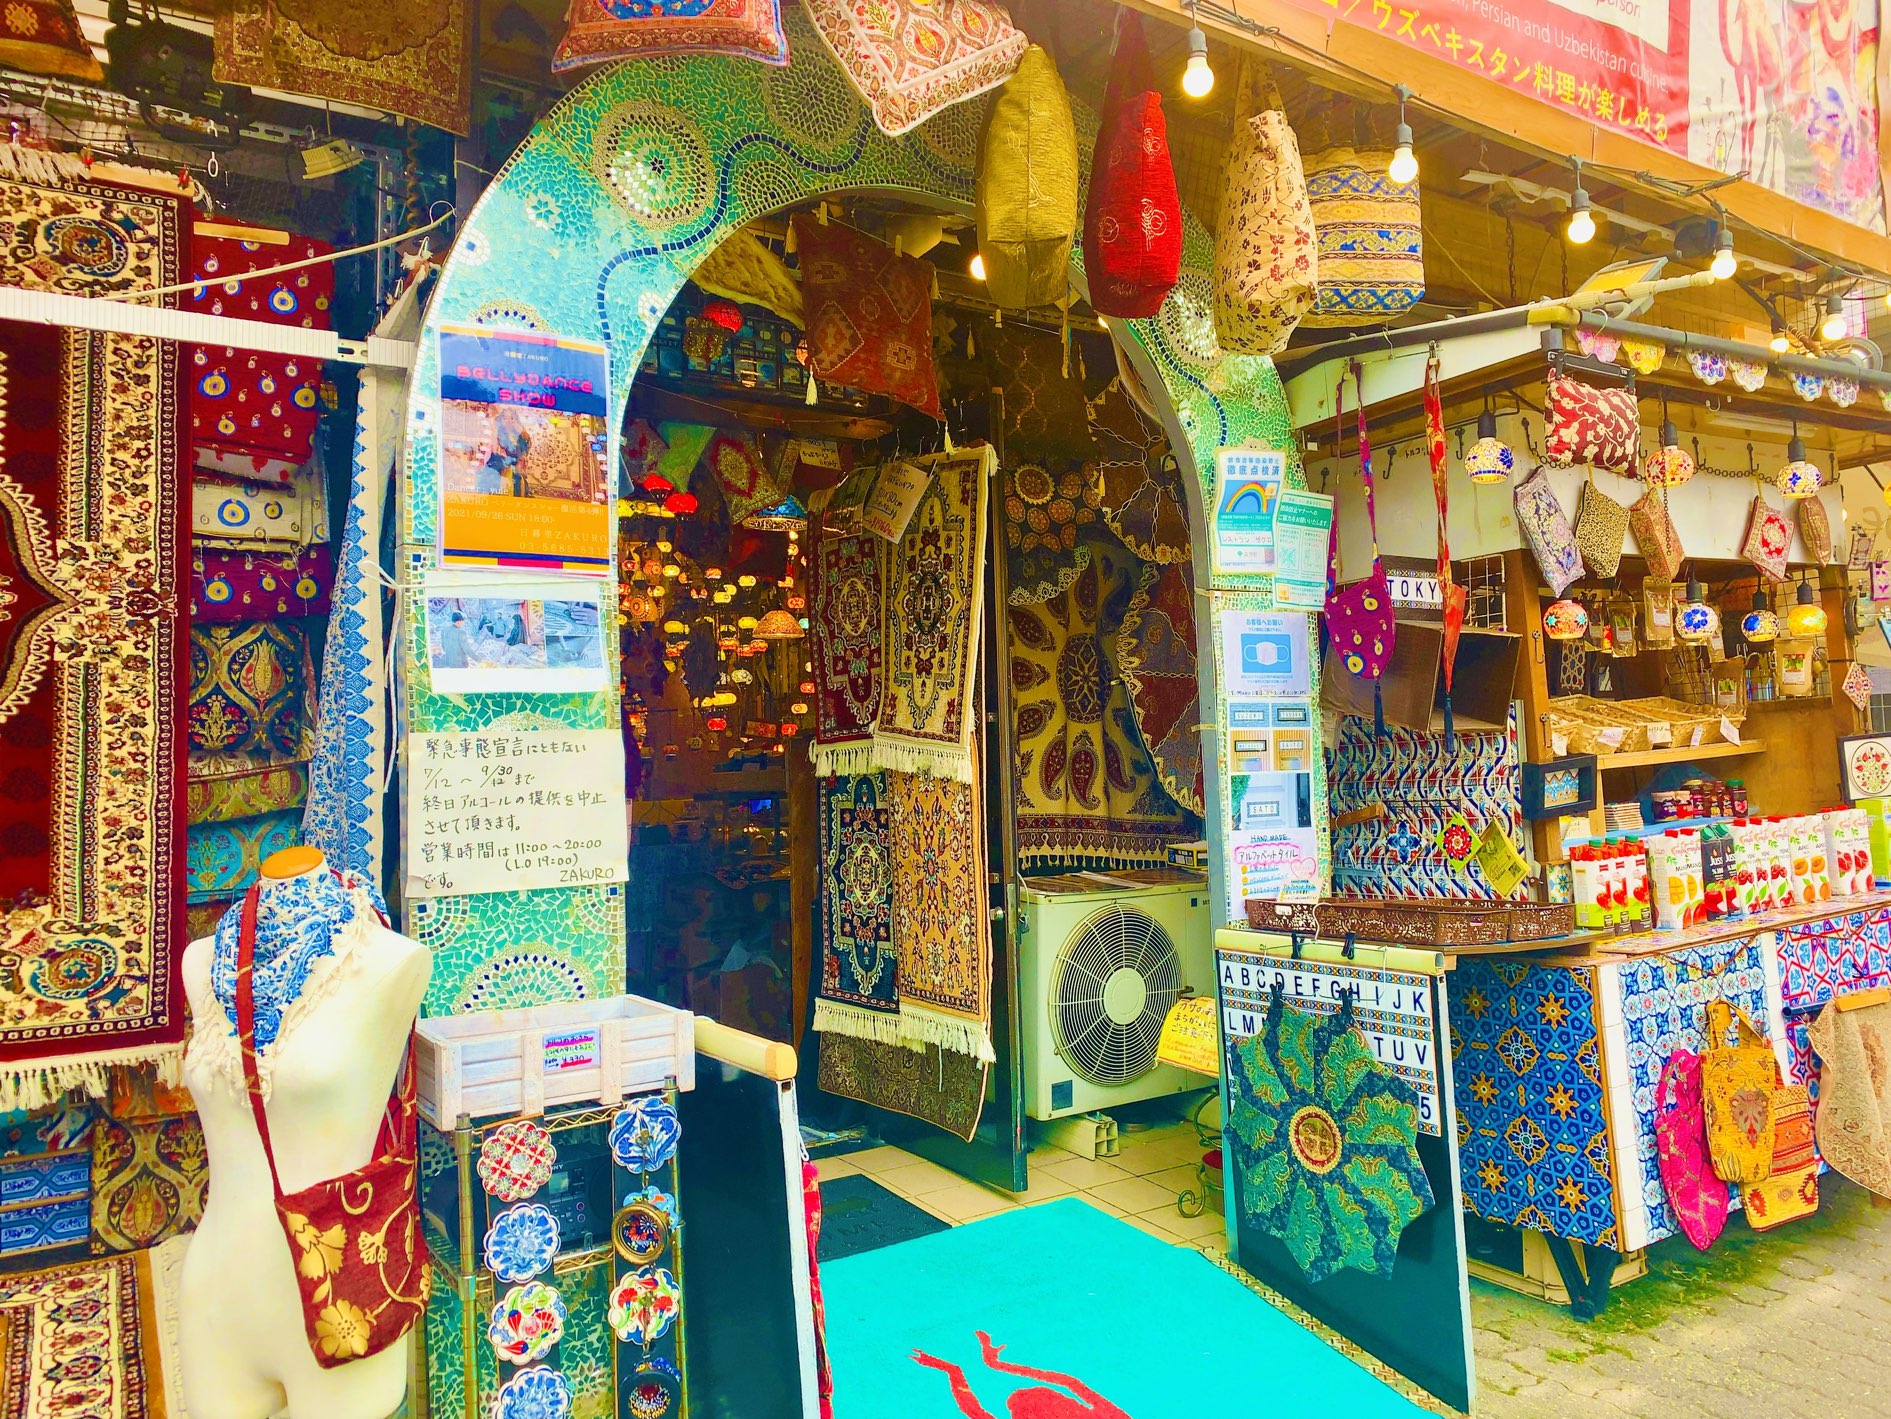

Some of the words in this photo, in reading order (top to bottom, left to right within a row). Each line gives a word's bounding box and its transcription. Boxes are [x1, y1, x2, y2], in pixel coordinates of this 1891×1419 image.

[1524, 20, 1550, 44] and
[1554, 30, 1627, 73] Uzbekistan
[1630, 61, 1669, 94] cuisine.
[456, 364, 593, 393] BELLYDANCE
[499, 388, 556, 407] SHOW
[506, 512, 526, 521] SUN
[1388, 579, 1441, 600] TOKY
[426, 736, 587, 759] 緊急事態宣言にともない
[1253, 805, 1275, 813] SATO
[424, 814, 520, 835] させて頂きます。
[424, 871, 453, 889] です。
[560, 867, 614, 882] ZAKURO
[1420, 1096, 1431, 1120] 5
